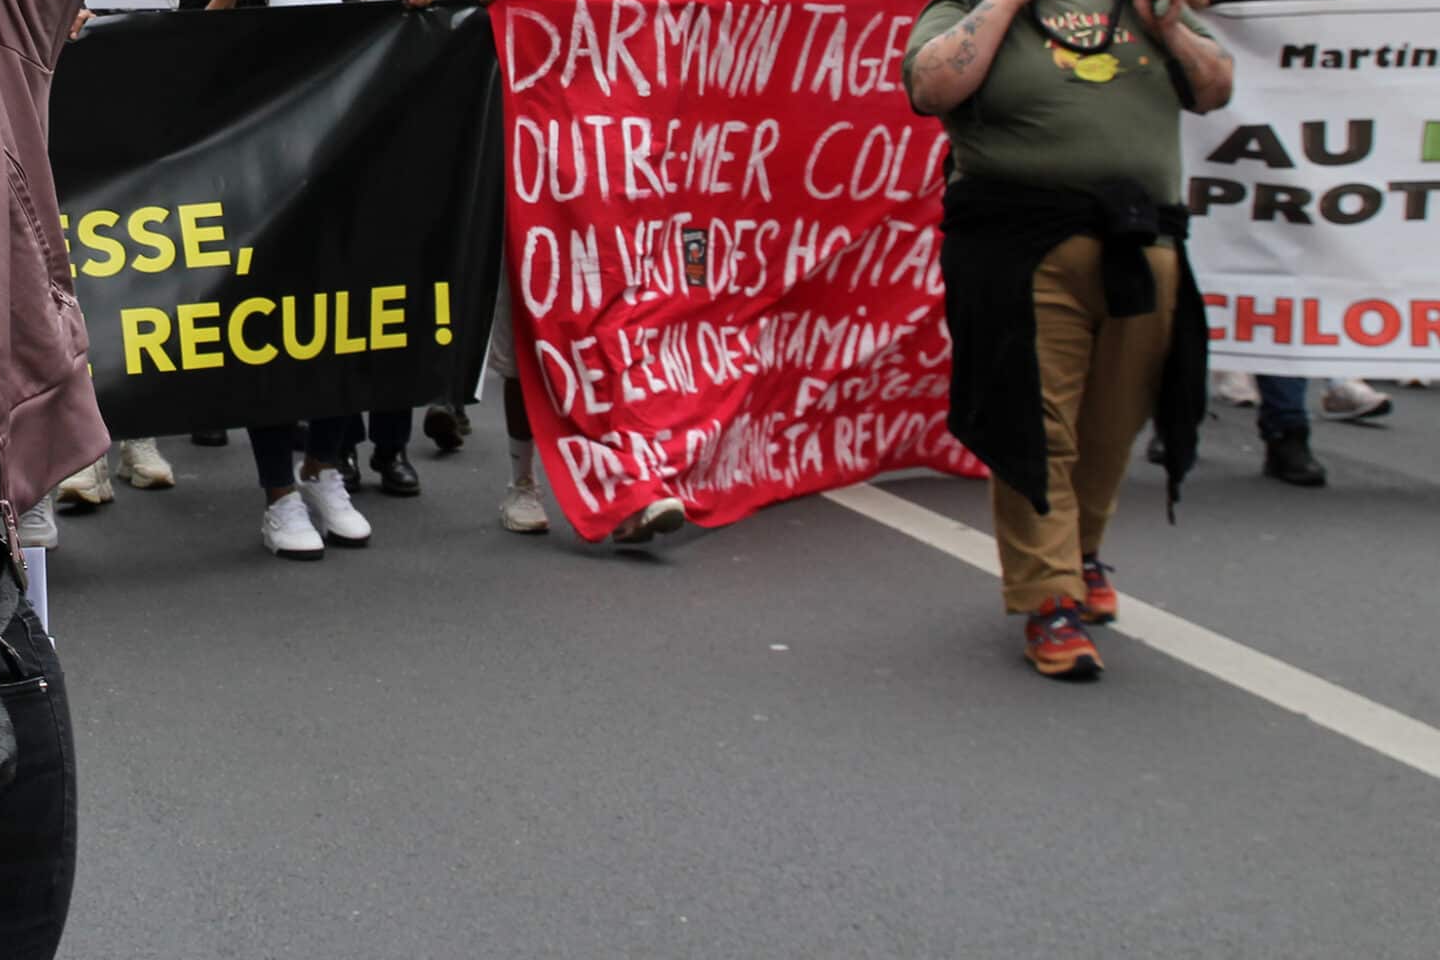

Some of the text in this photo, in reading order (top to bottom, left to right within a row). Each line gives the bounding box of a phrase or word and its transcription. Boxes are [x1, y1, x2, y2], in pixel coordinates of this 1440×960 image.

[1207, 118, 1376, 170] AU
[520, 224, 602, 318] ON
[707, 218, 780, 300] DES
[119, 284, 408, 376] RECULE
[433, 281, 454, 346] !
[535, 336, 613, 418] DE
